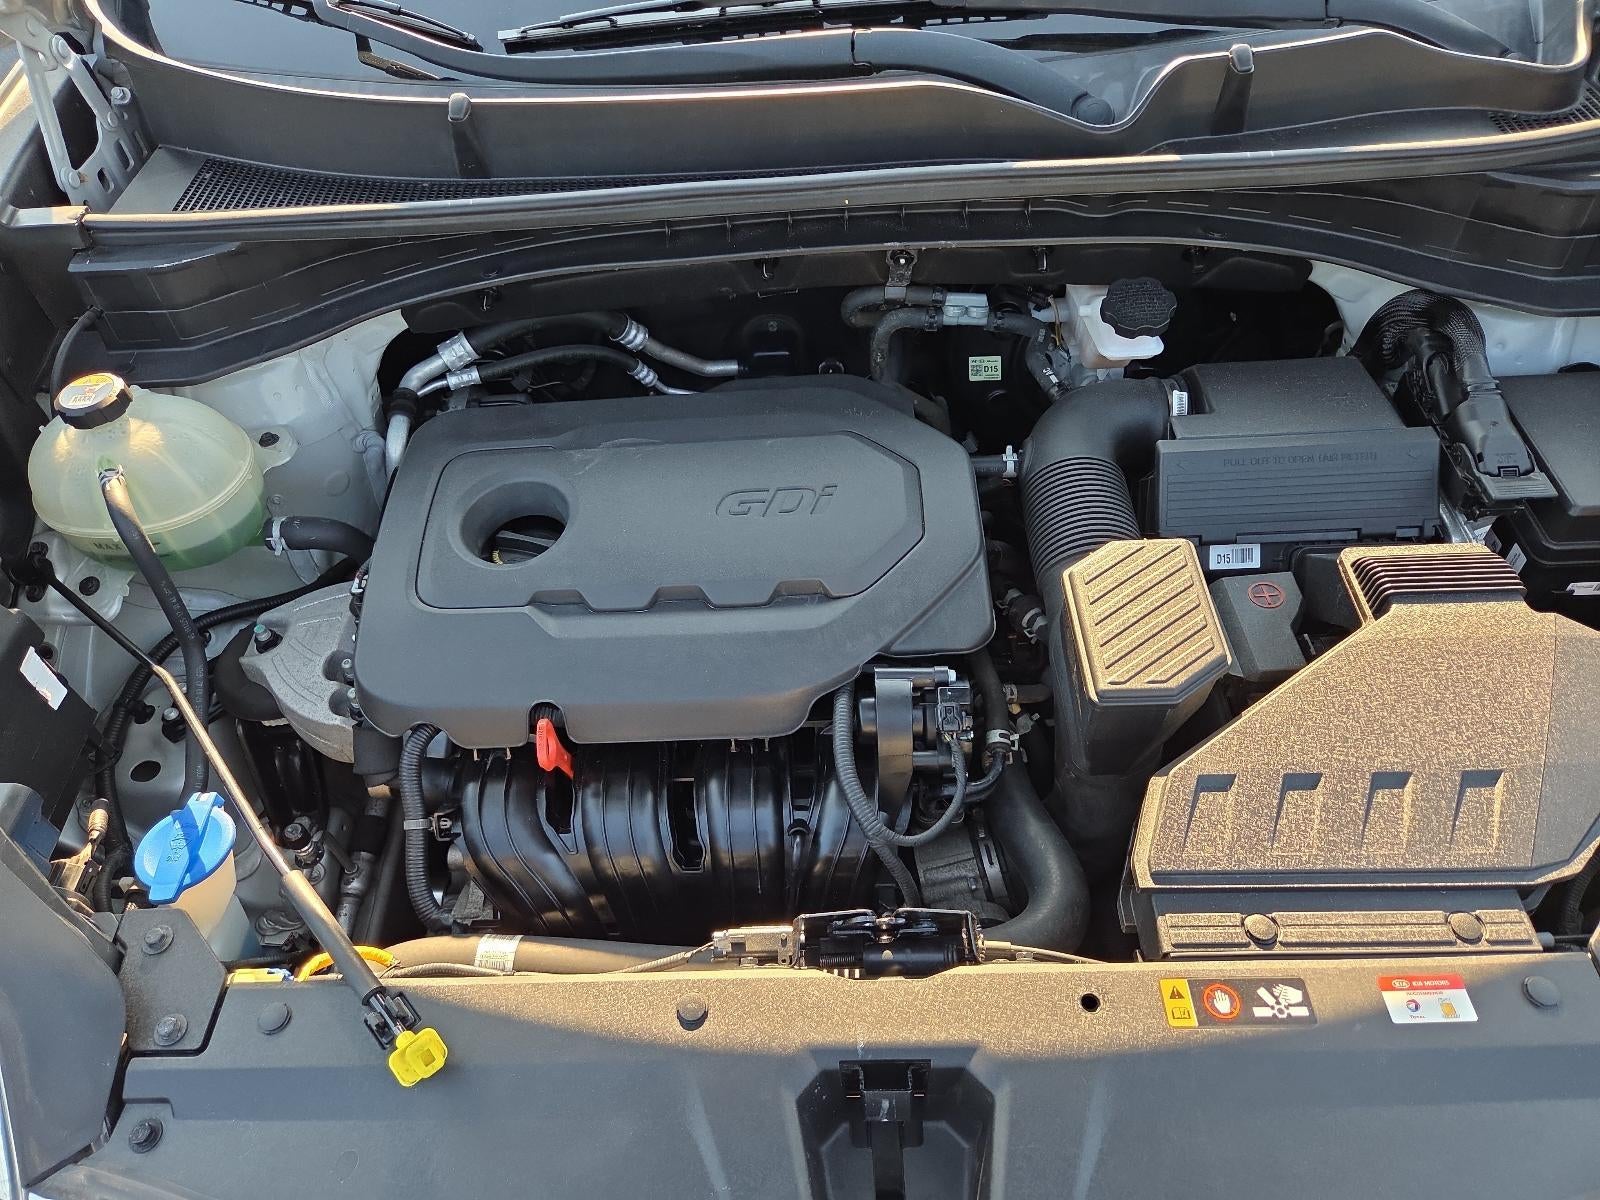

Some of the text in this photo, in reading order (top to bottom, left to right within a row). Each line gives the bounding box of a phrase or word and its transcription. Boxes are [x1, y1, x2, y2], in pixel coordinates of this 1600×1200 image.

[983, 365, 999, 373] D15
[1223, 458, 1246, 468] PULL
[1287, 455, 1315, 464] OPEN
[715, 485, 838, 518] GDi
[92, 542, 122, 551] MAX
[1216, 553, 1231, 564] D15
